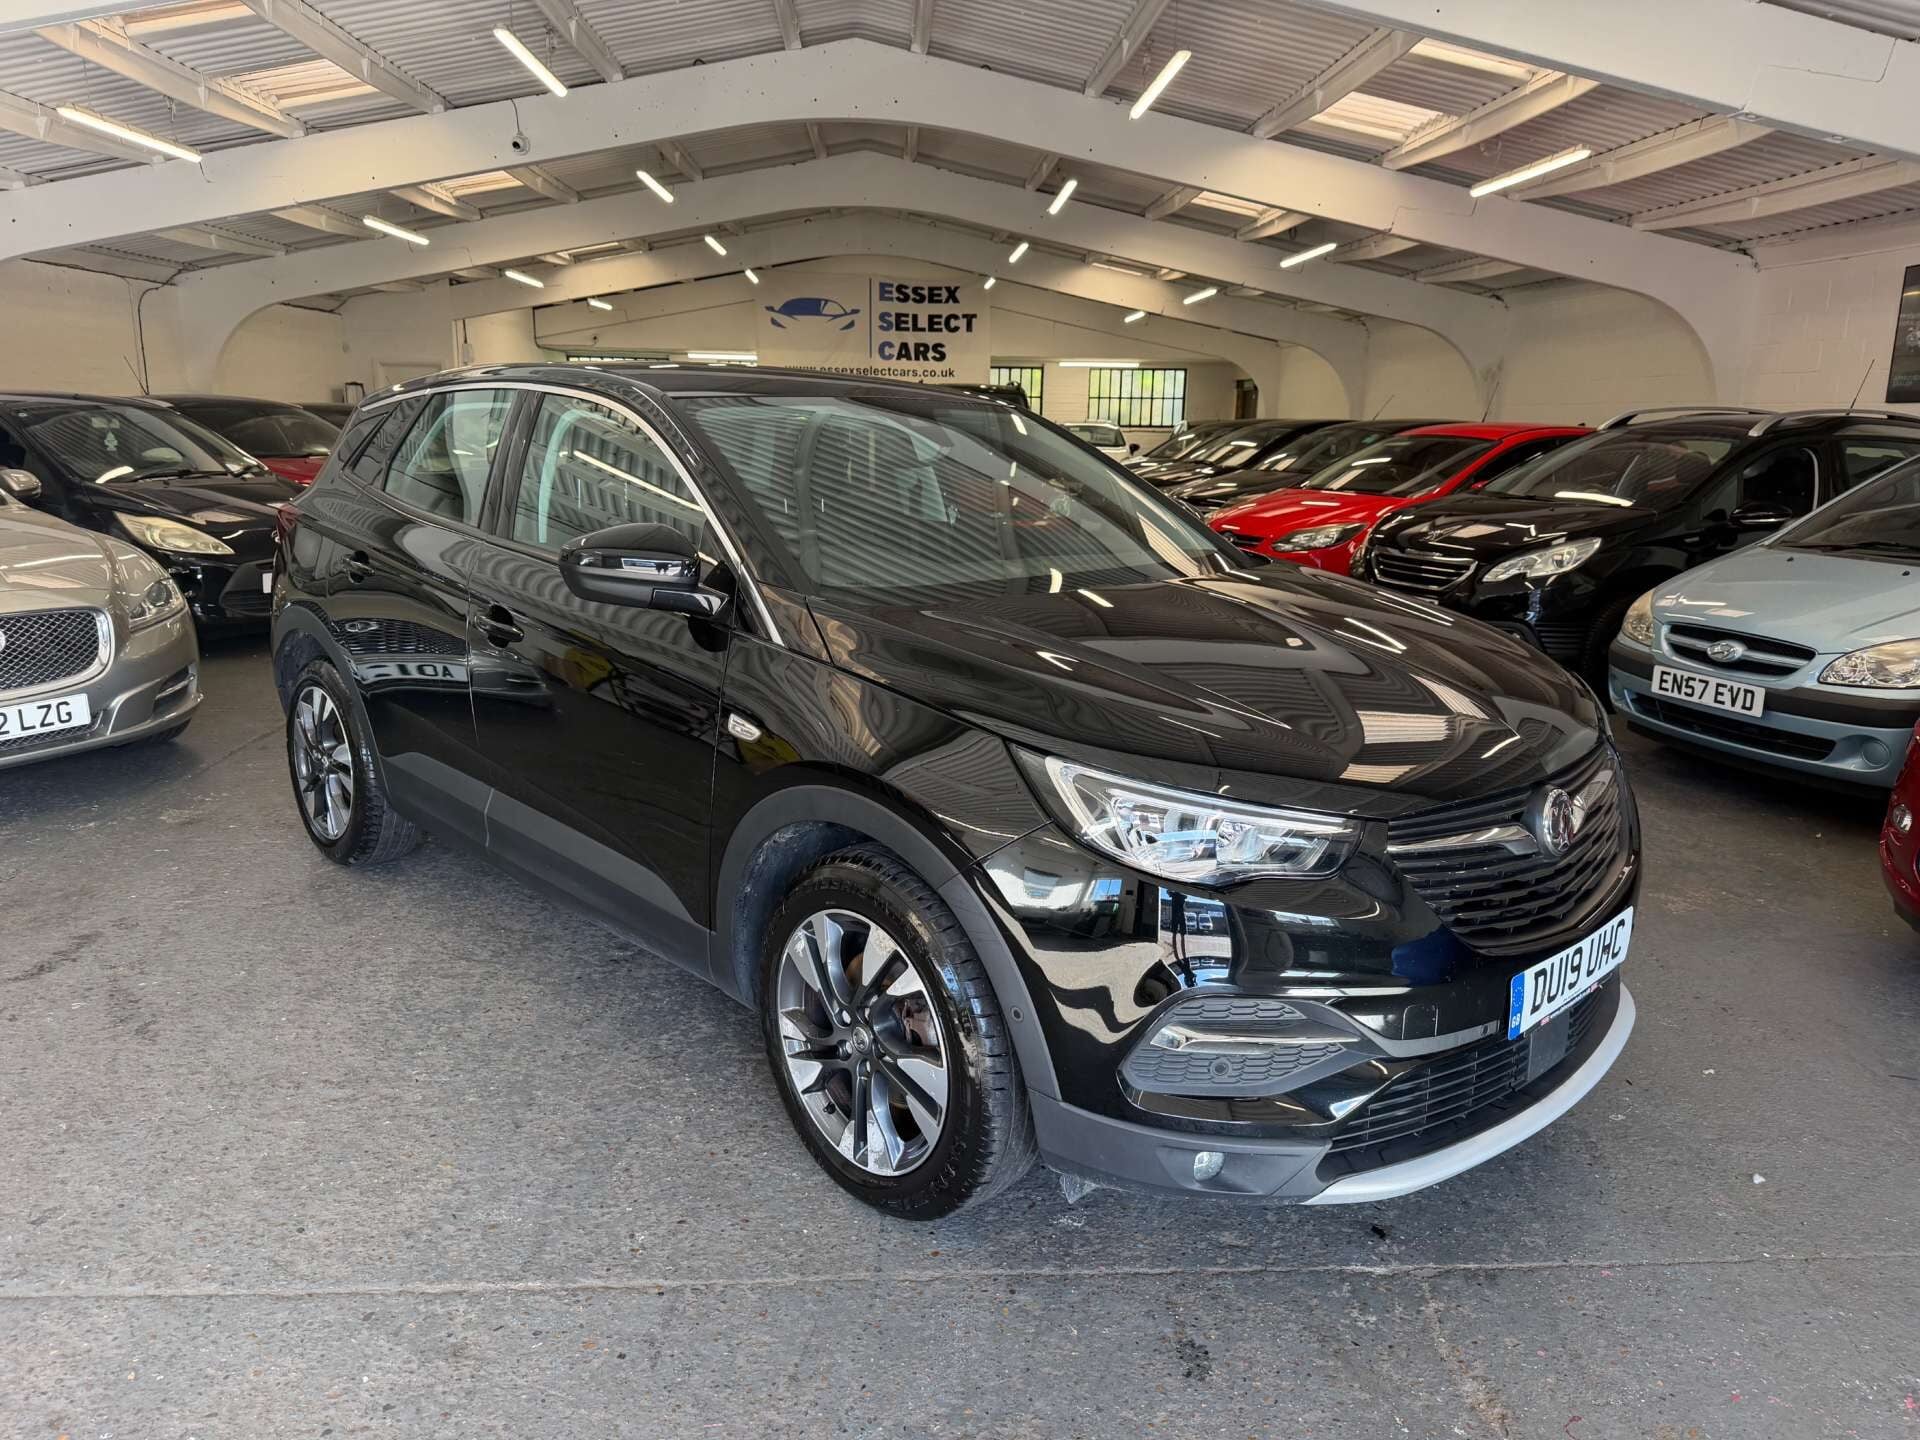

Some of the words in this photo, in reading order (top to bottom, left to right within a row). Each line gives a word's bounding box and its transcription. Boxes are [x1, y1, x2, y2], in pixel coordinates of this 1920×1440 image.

[878, 281, 961, 304] ESSEX
[878, 311, 978, 333] SELECT
[878, 341, 947, 362] CARS
[785, 365, 955, 378] essexselectcars.co.uk
[1658, 670, 1709, 700] EN57
[1713, 683, 1756, 712] EVD
[18, 701, 72, 731] LZG
[1530, 946, 1583, 1016] DU19
[1586, 918, 1626, 978] UHC
